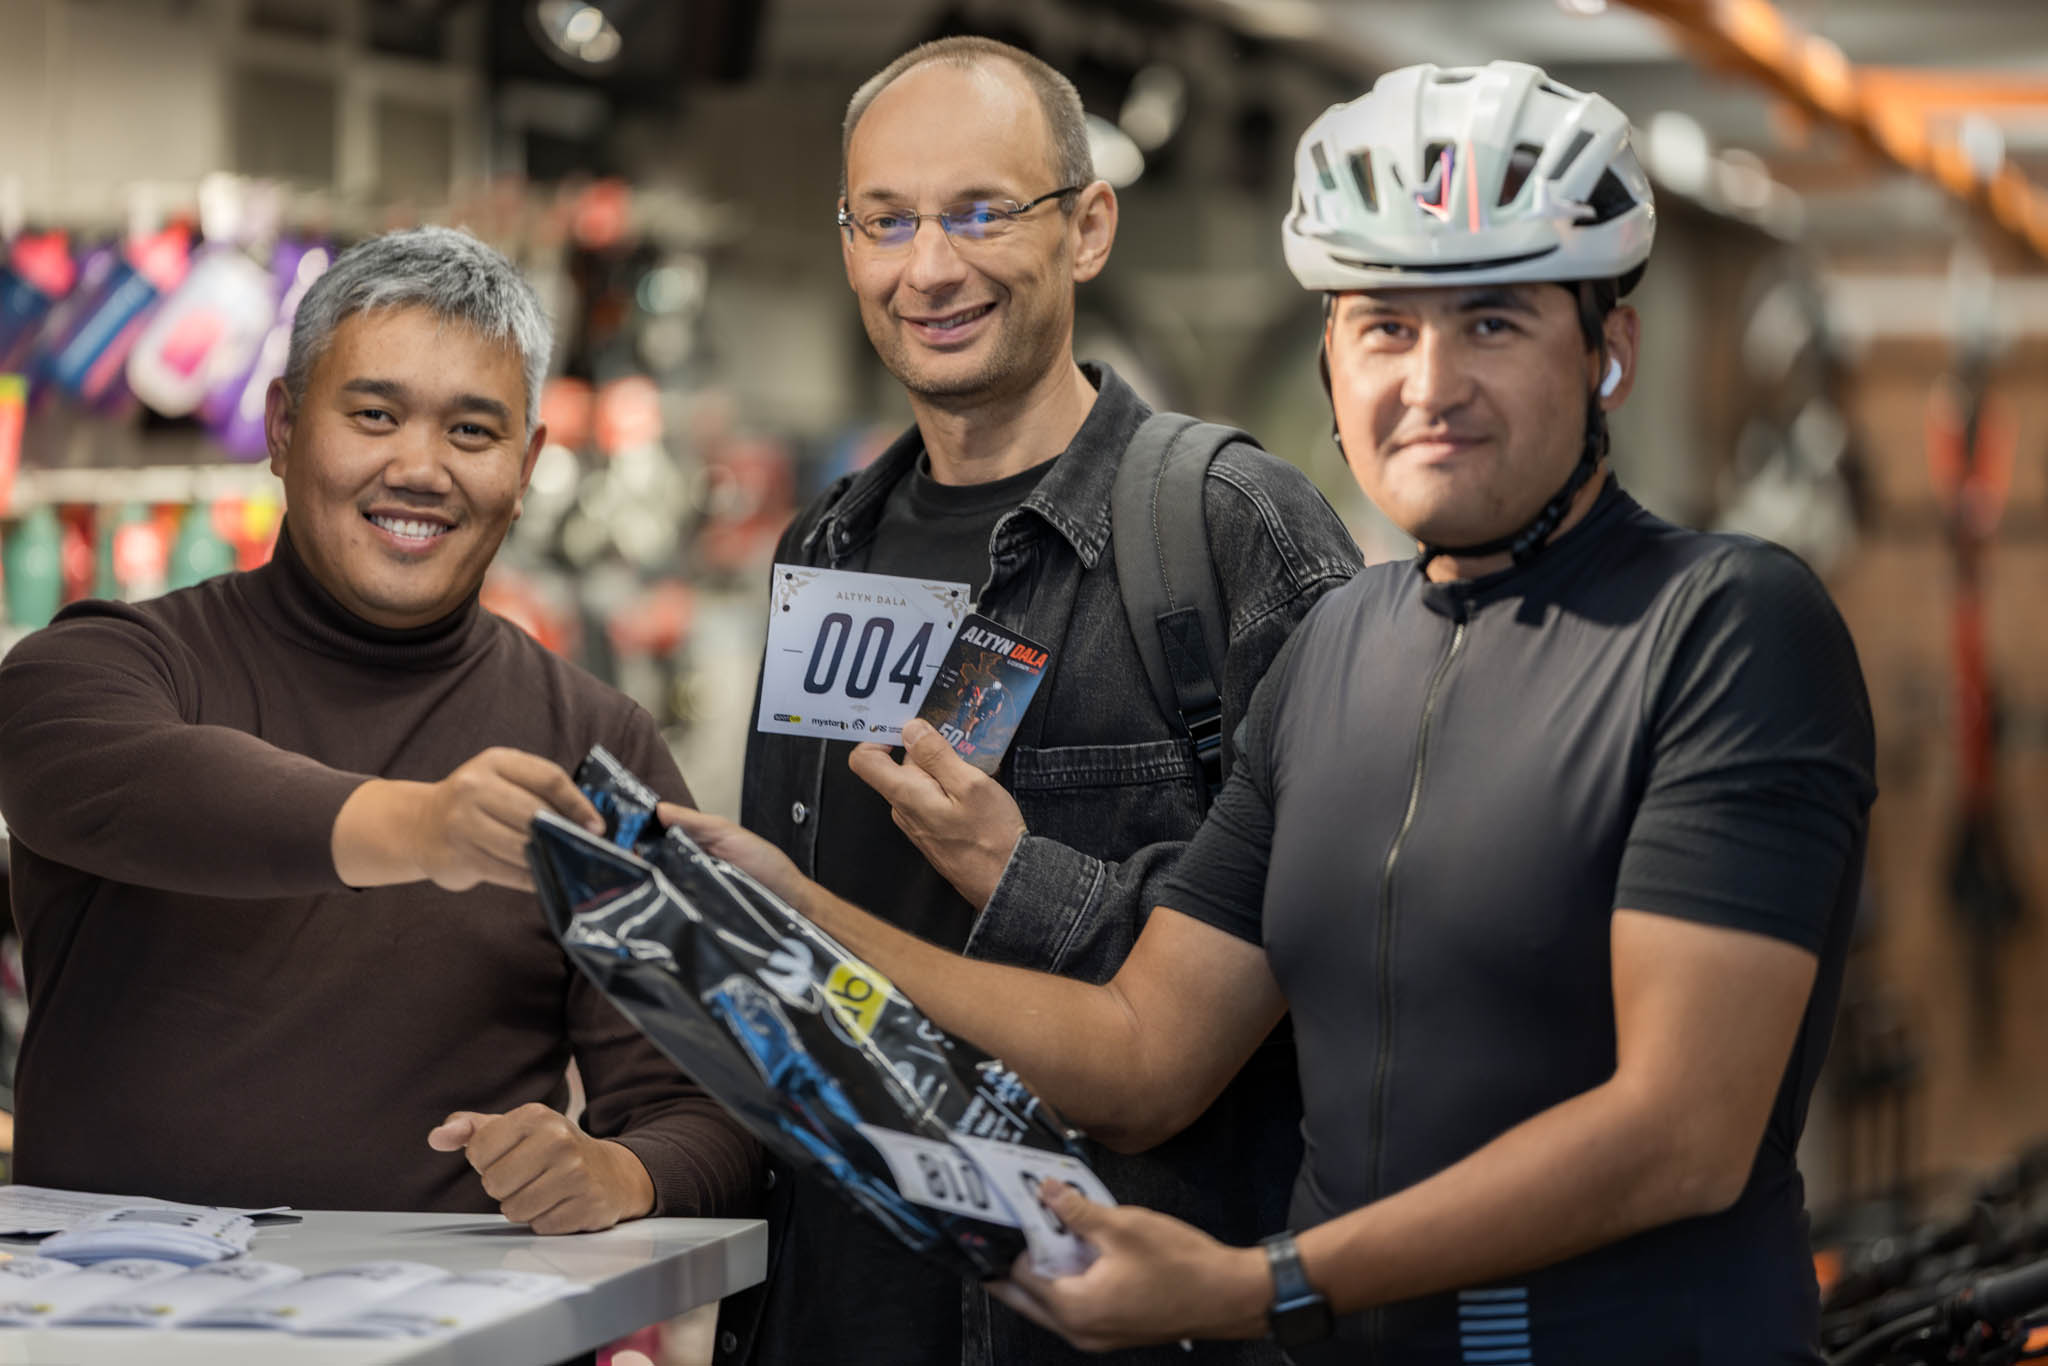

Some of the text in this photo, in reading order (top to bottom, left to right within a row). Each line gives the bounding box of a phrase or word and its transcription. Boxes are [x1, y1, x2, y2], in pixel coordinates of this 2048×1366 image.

[836, 591, 906, 607] ALTYN DALA
[803, 612, 935, 704] 004
[960, 626, 1016, 656] ALTYN
[1009, 643, 1049, 669] DALA
